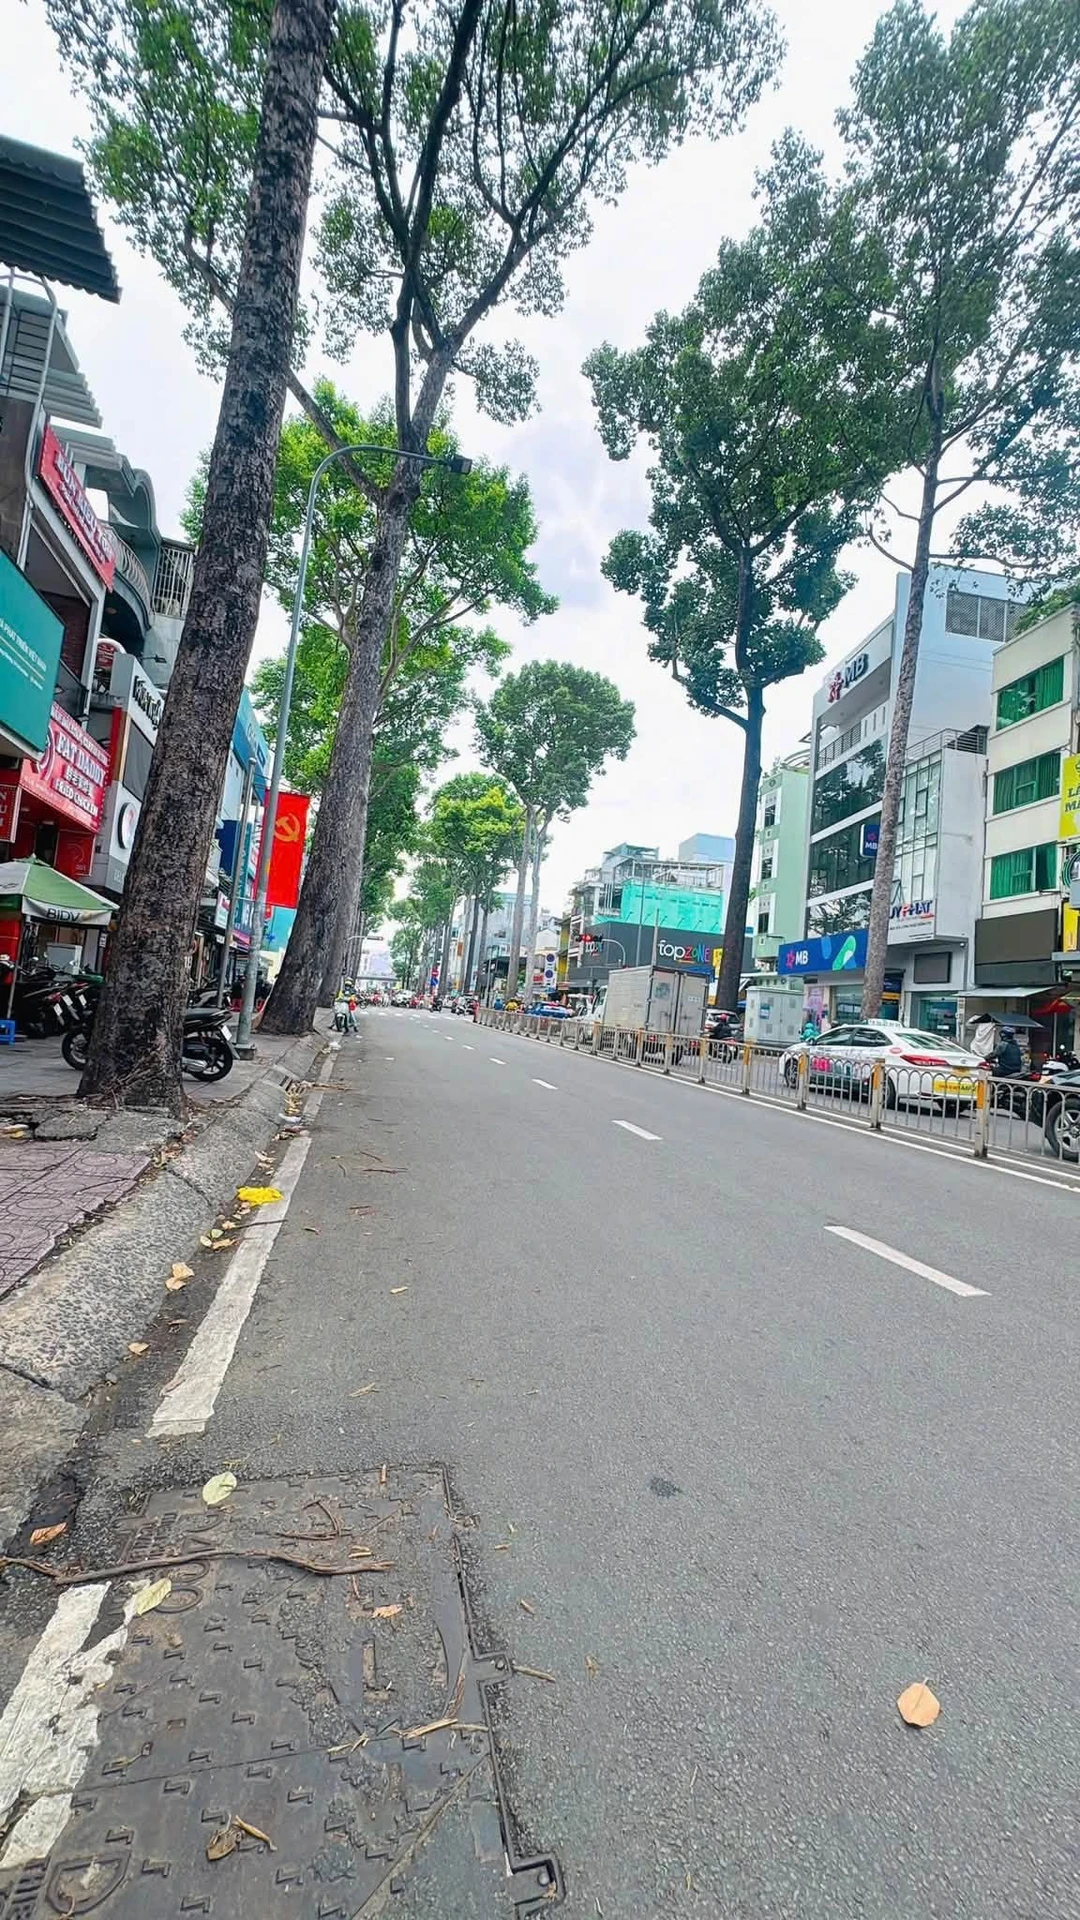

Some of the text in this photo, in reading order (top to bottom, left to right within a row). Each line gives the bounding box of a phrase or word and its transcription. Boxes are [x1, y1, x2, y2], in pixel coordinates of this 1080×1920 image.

[845, 654, 869, 688] MB
[56, 732, 77, 764] FAT
[78, 748, 106, 788] DADDY
[56, 779, 74, 800] FRIED
[865, 842, 878, 850] MB
[46, 908, 80, 922] BIDV
[795, 951, 809, 965] MB
